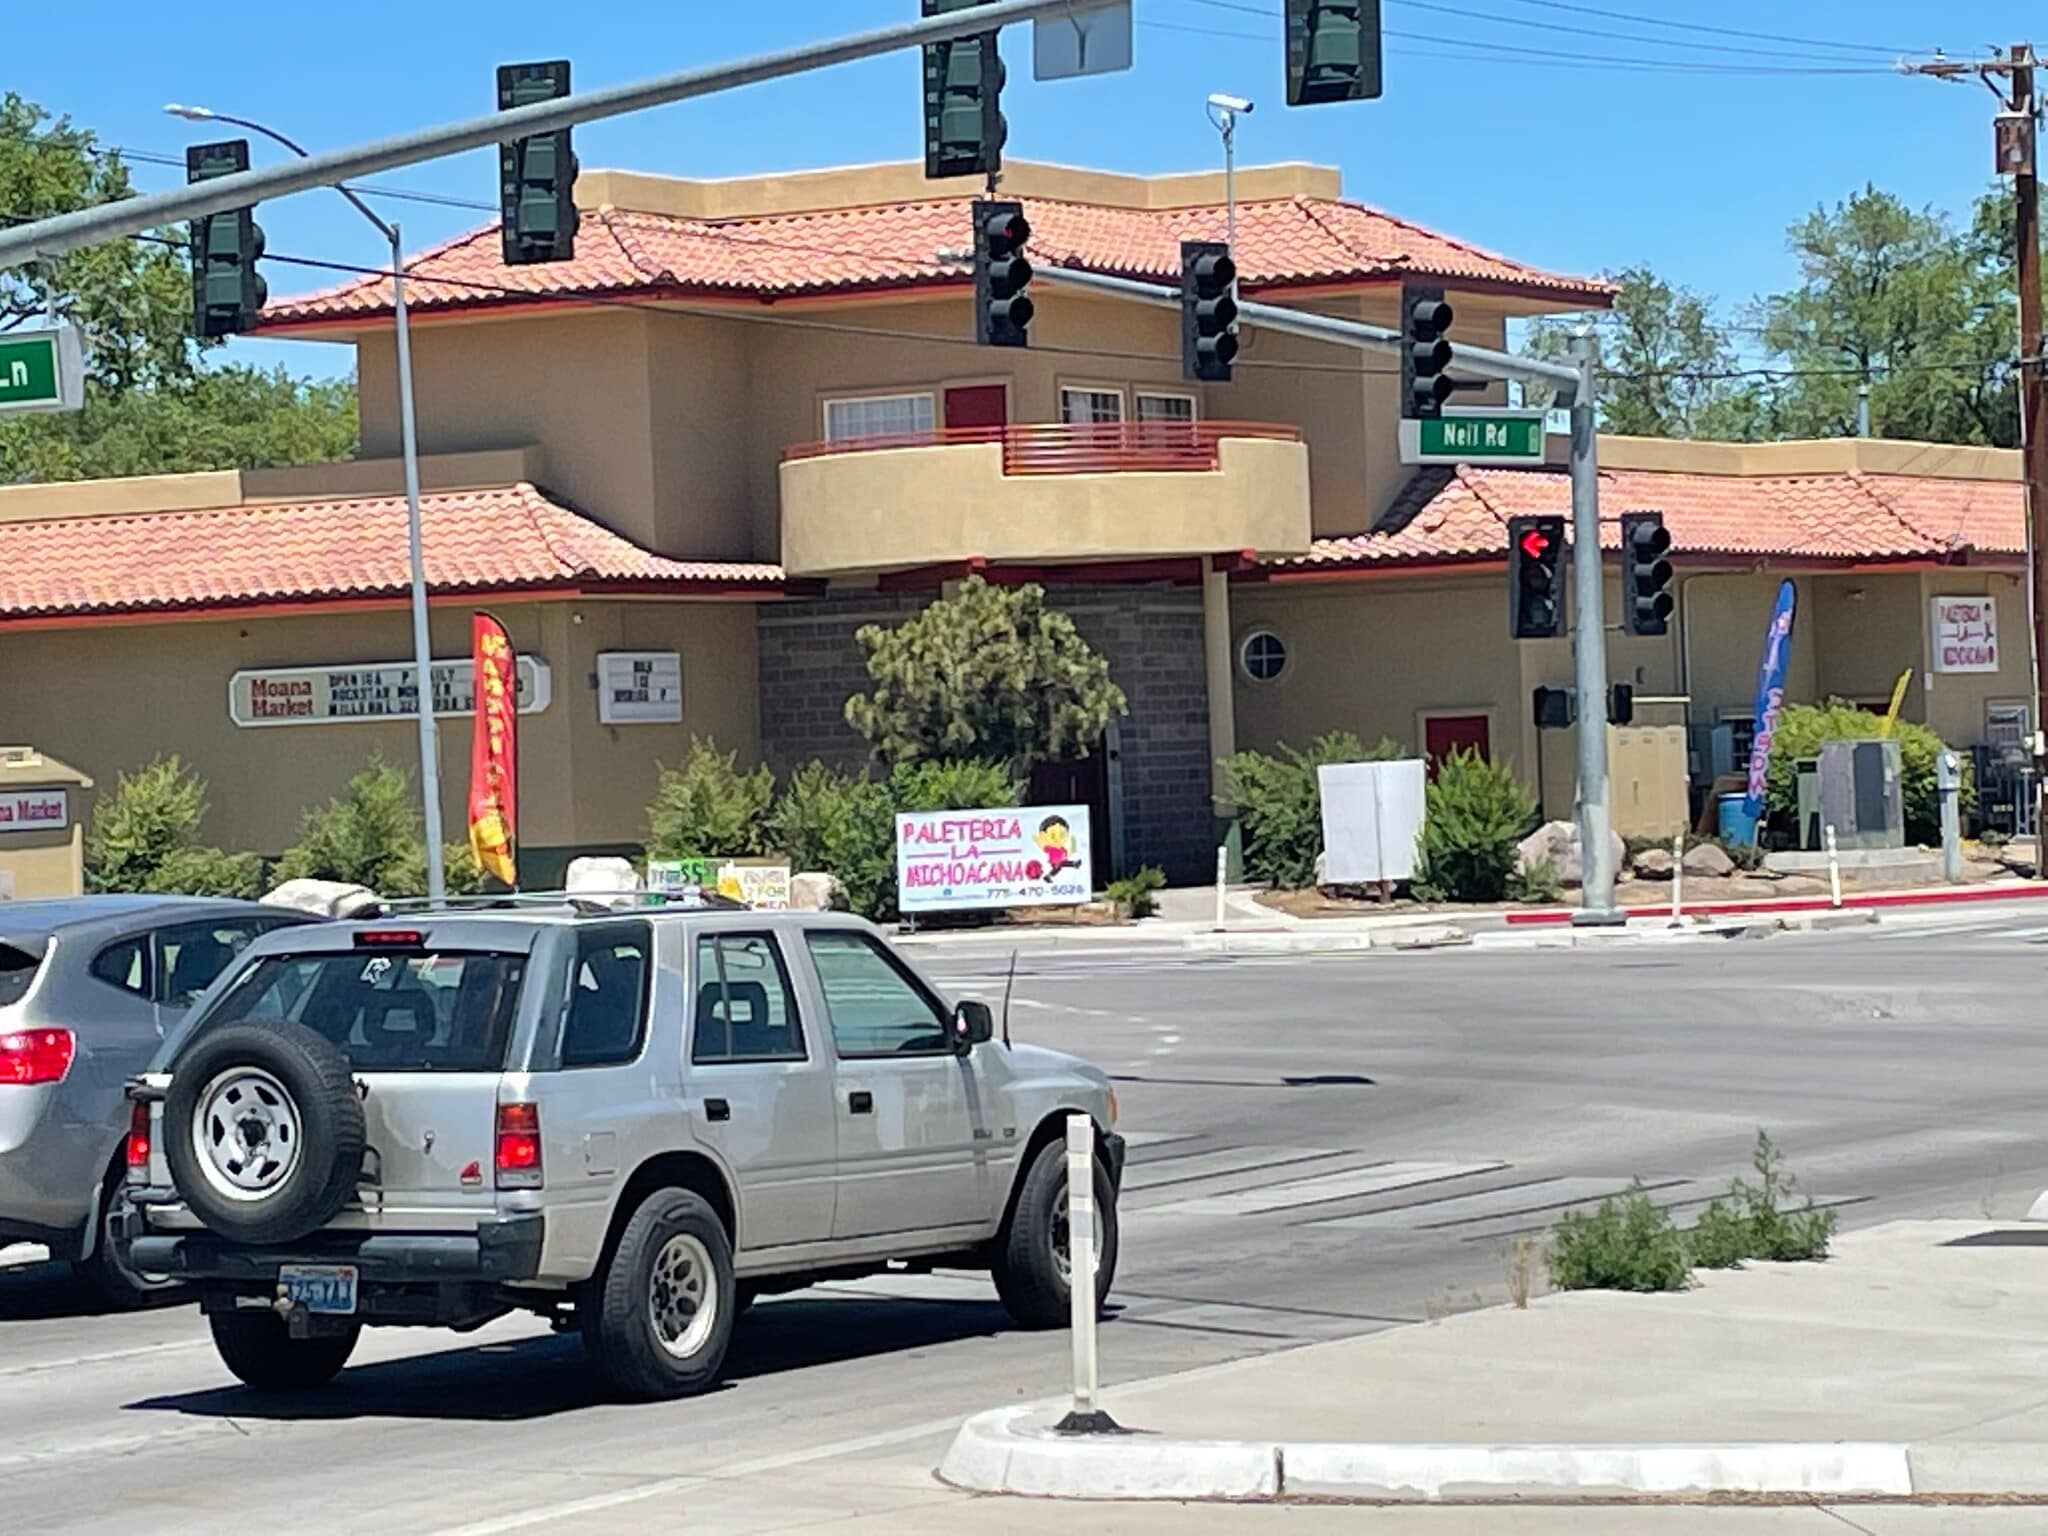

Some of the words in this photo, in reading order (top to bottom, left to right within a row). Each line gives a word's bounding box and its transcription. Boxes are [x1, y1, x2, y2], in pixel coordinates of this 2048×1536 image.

[1443, 423, 1480, 447] Neil
[1485, 423, 1507, 447] Rd
[252, 679, 313, 698] Moana
[252, 699, 314, 718] Market
[903, 818, 1023, 844] PALETERIA
[950, 844, 981, 860] LA
[905, 859, 1024, 888] MICHOACANA
